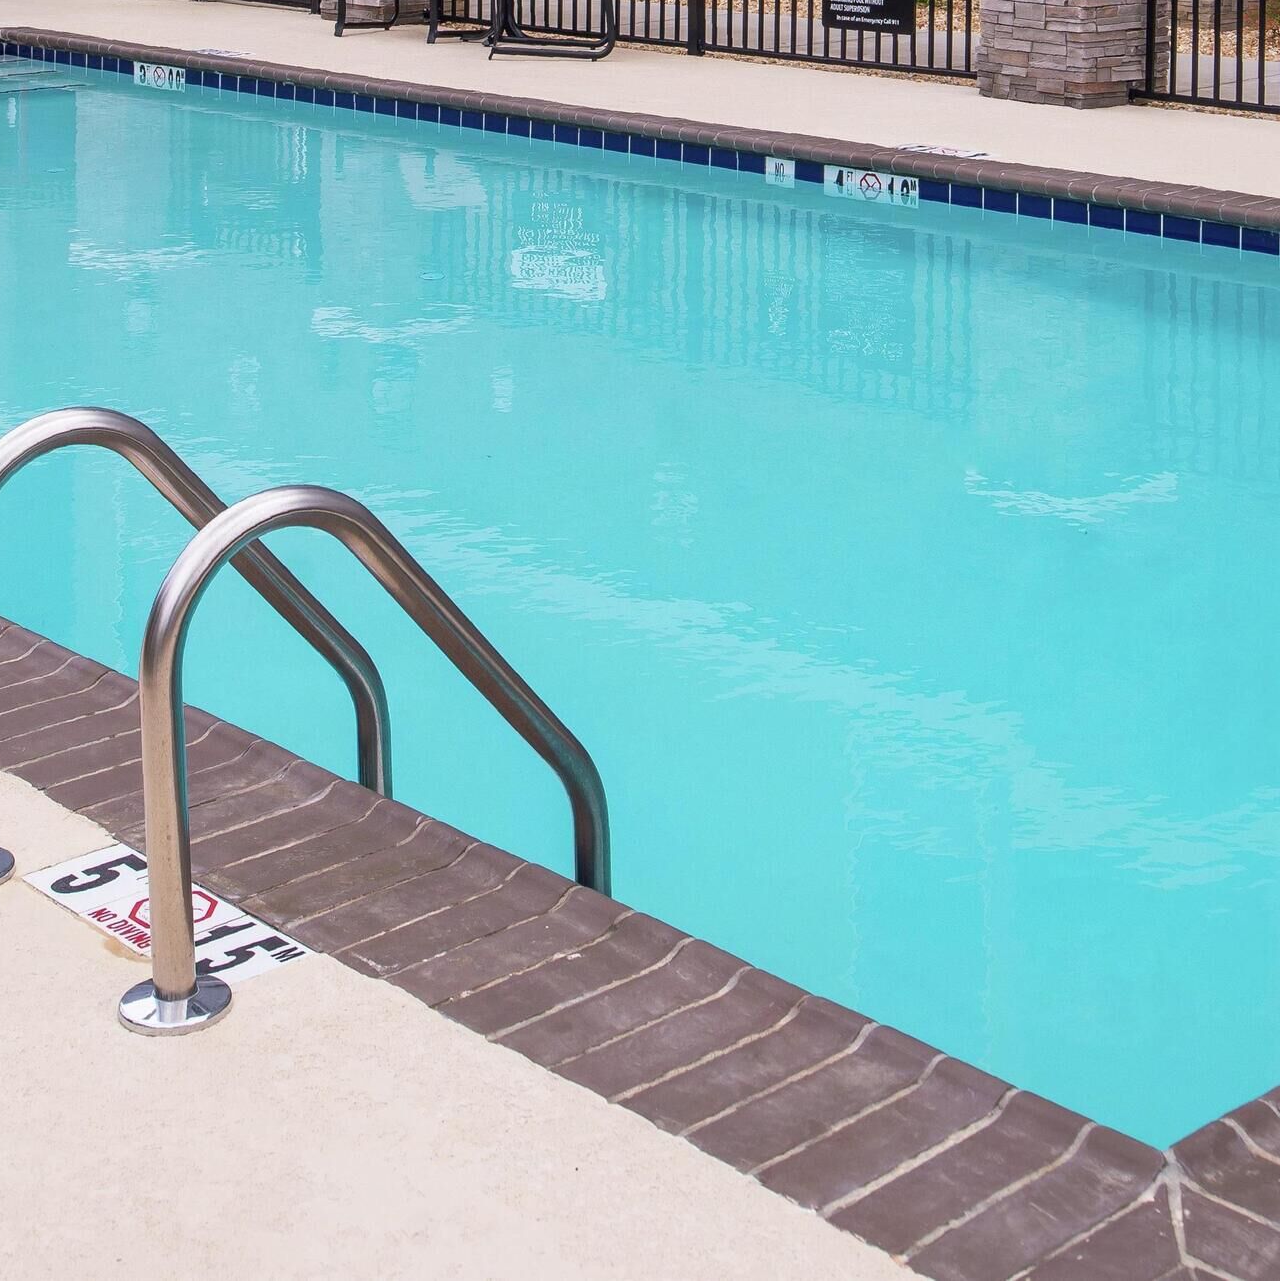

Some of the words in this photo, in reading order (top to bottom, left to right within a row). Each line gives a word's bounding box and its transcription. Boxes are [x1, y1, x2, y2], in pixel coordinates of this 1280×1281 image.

[50, 854, 148, 894] 5
[87, 908, 118, 922] NO
[106, 919, 151, 949] DIVING
[271, 946, 307, 963] M
